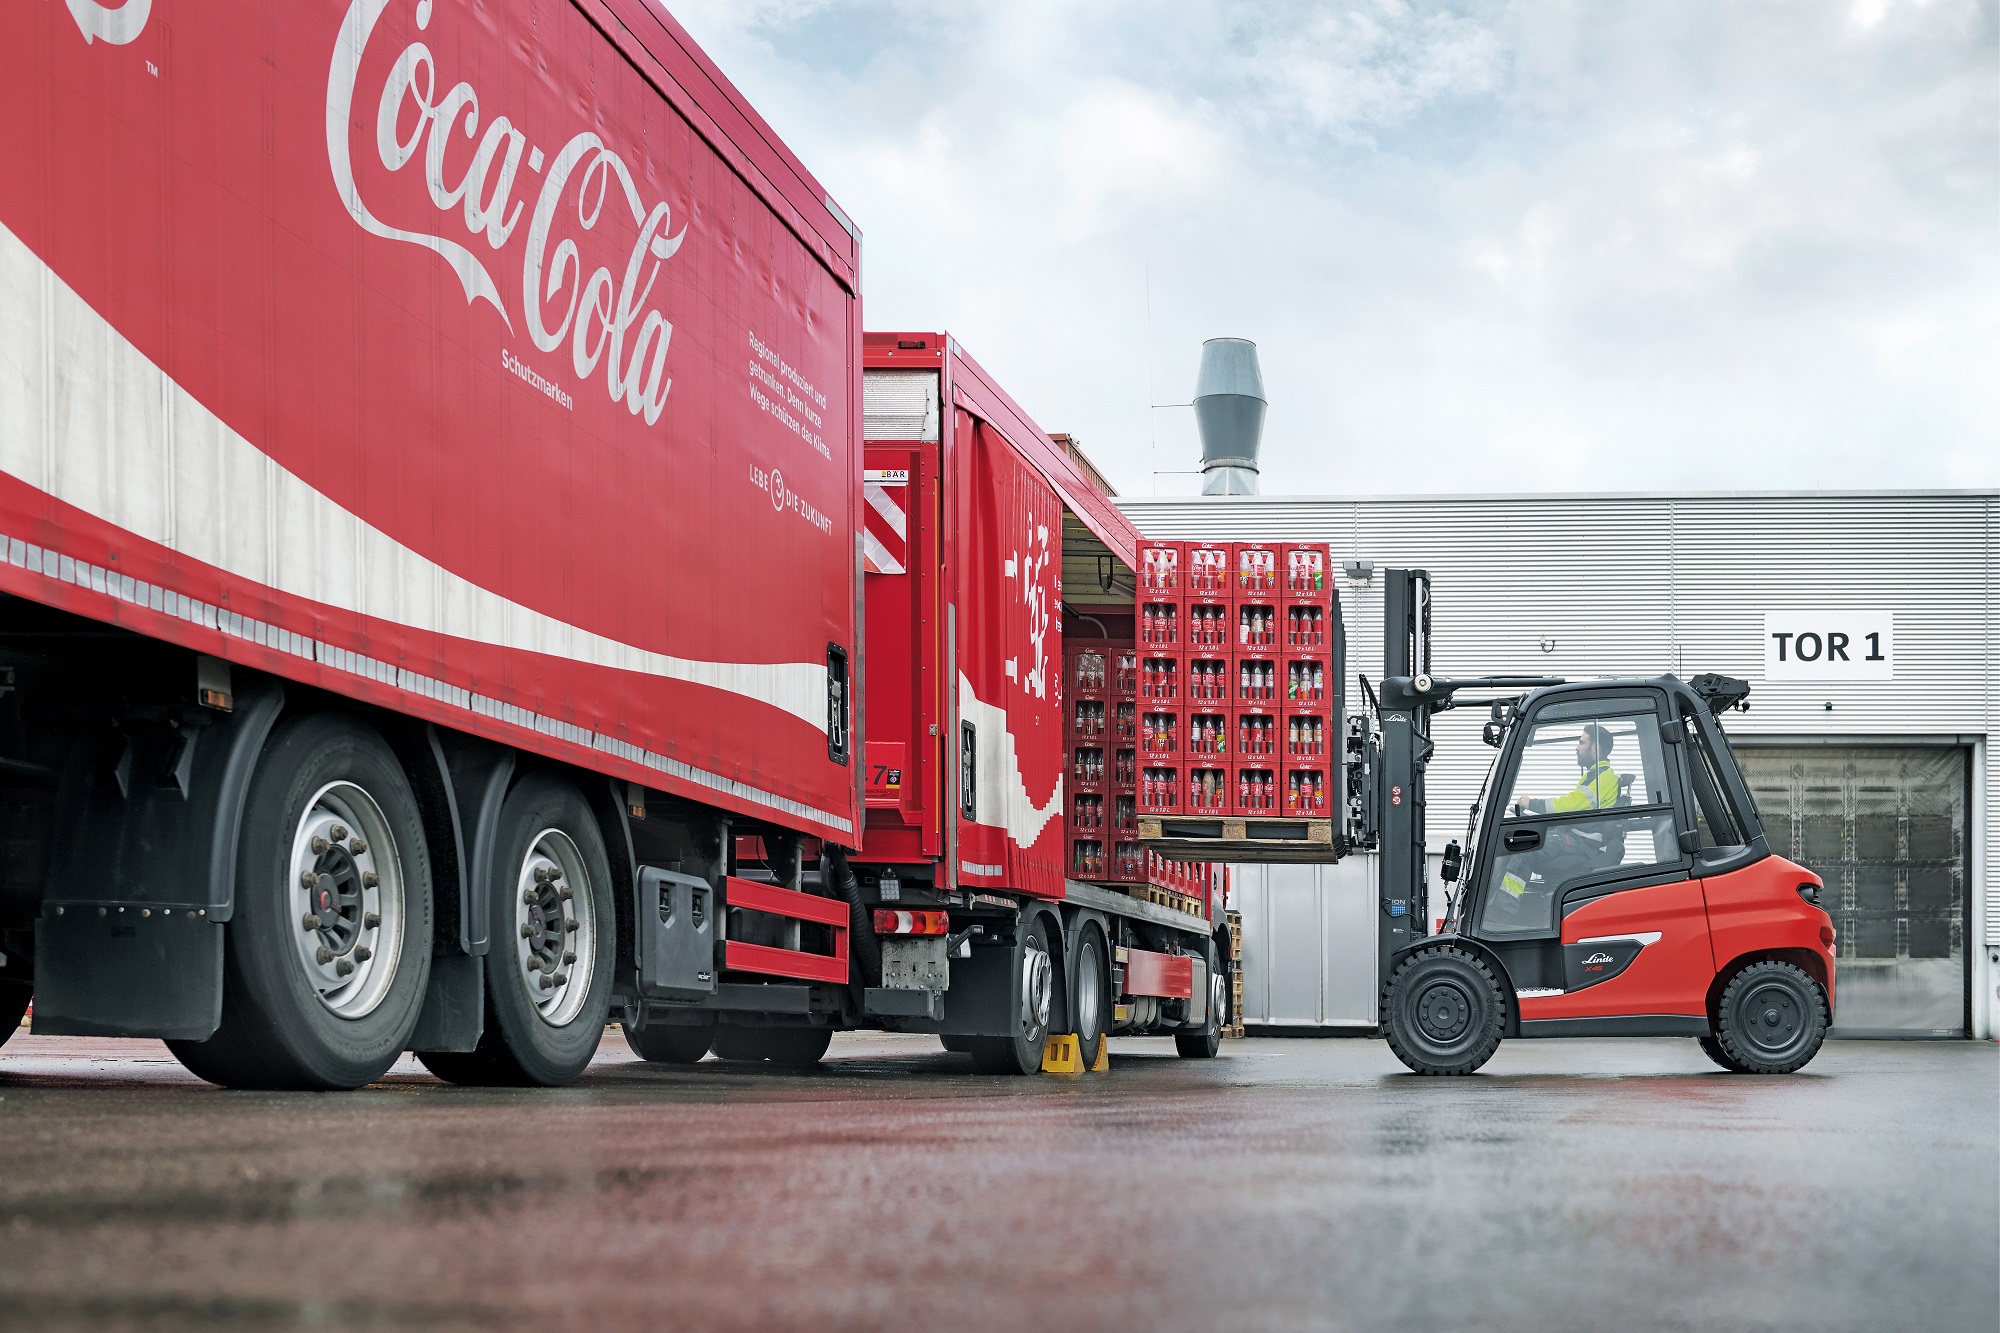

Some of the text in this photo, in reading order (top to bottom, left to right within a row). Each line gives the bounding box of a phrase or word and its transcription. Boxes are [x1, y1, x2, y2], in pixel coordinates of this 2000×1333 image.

[326, 0, 689, 426] Coca-Cola
[501, 348, 573, 412] Schutzmarken
[749, 330, 827, 410] Regional produziert und
[749, 359, 822, 429] getrunken. Denn kurze
[749, 381, 832, 461] Wege schützen das Klima.
[749, 463, 833, 537] LEBE DIE ZUKUNFT
[886, 470, 905, 478] BÄR
[1772, 632, 1885, 663] TOR 1
[1581, 952, 1614, 964] Linde
